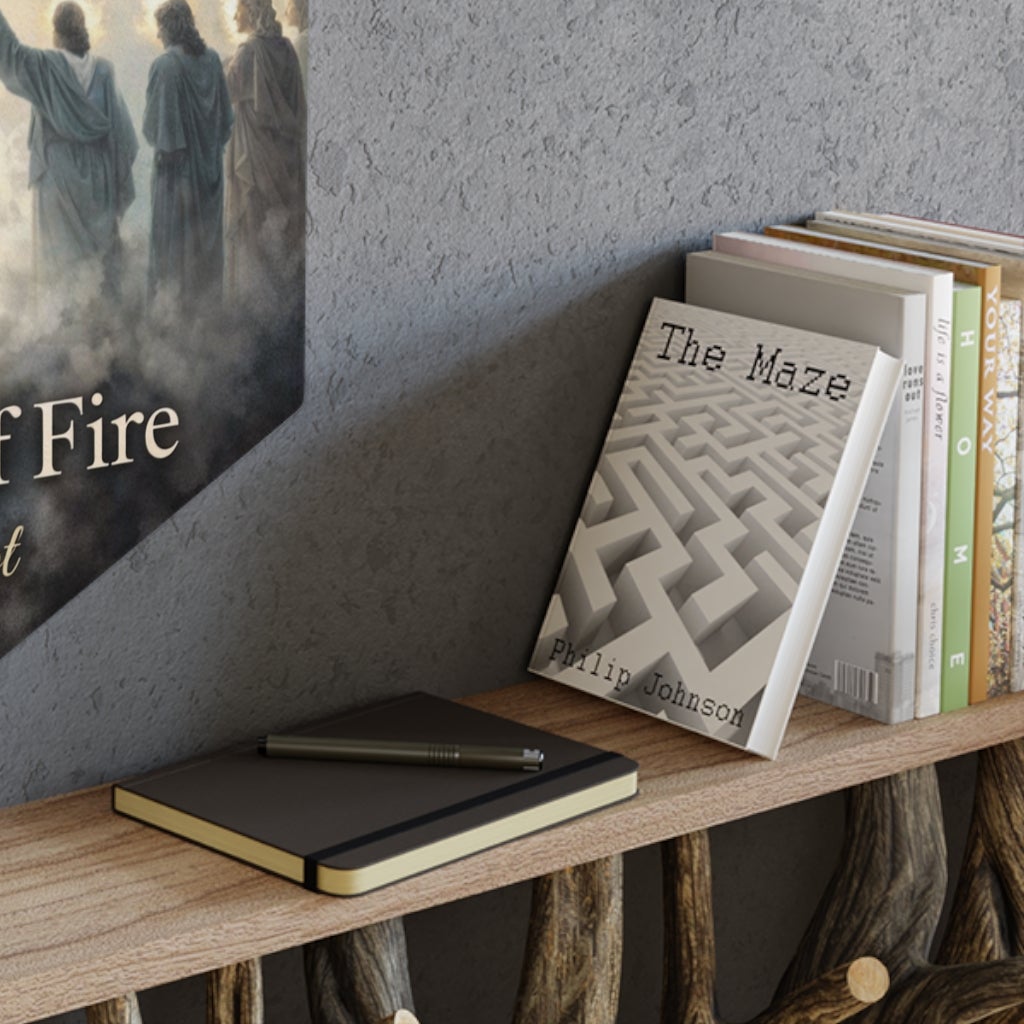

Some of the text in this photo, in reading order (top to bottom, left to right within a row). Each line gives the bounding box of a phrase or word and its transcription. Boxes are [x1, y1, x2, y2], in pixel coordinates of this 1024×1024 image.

[656, 322, 851, 401] The Maze
[904, 389, 921, 402] out
[931, 318, 950, 440] life is a flower
[982, 287, 998, 454] YOUR WAY
[33, 392, 180, 479] Fire
[549, 638, 745, 727] Philip Johnson
